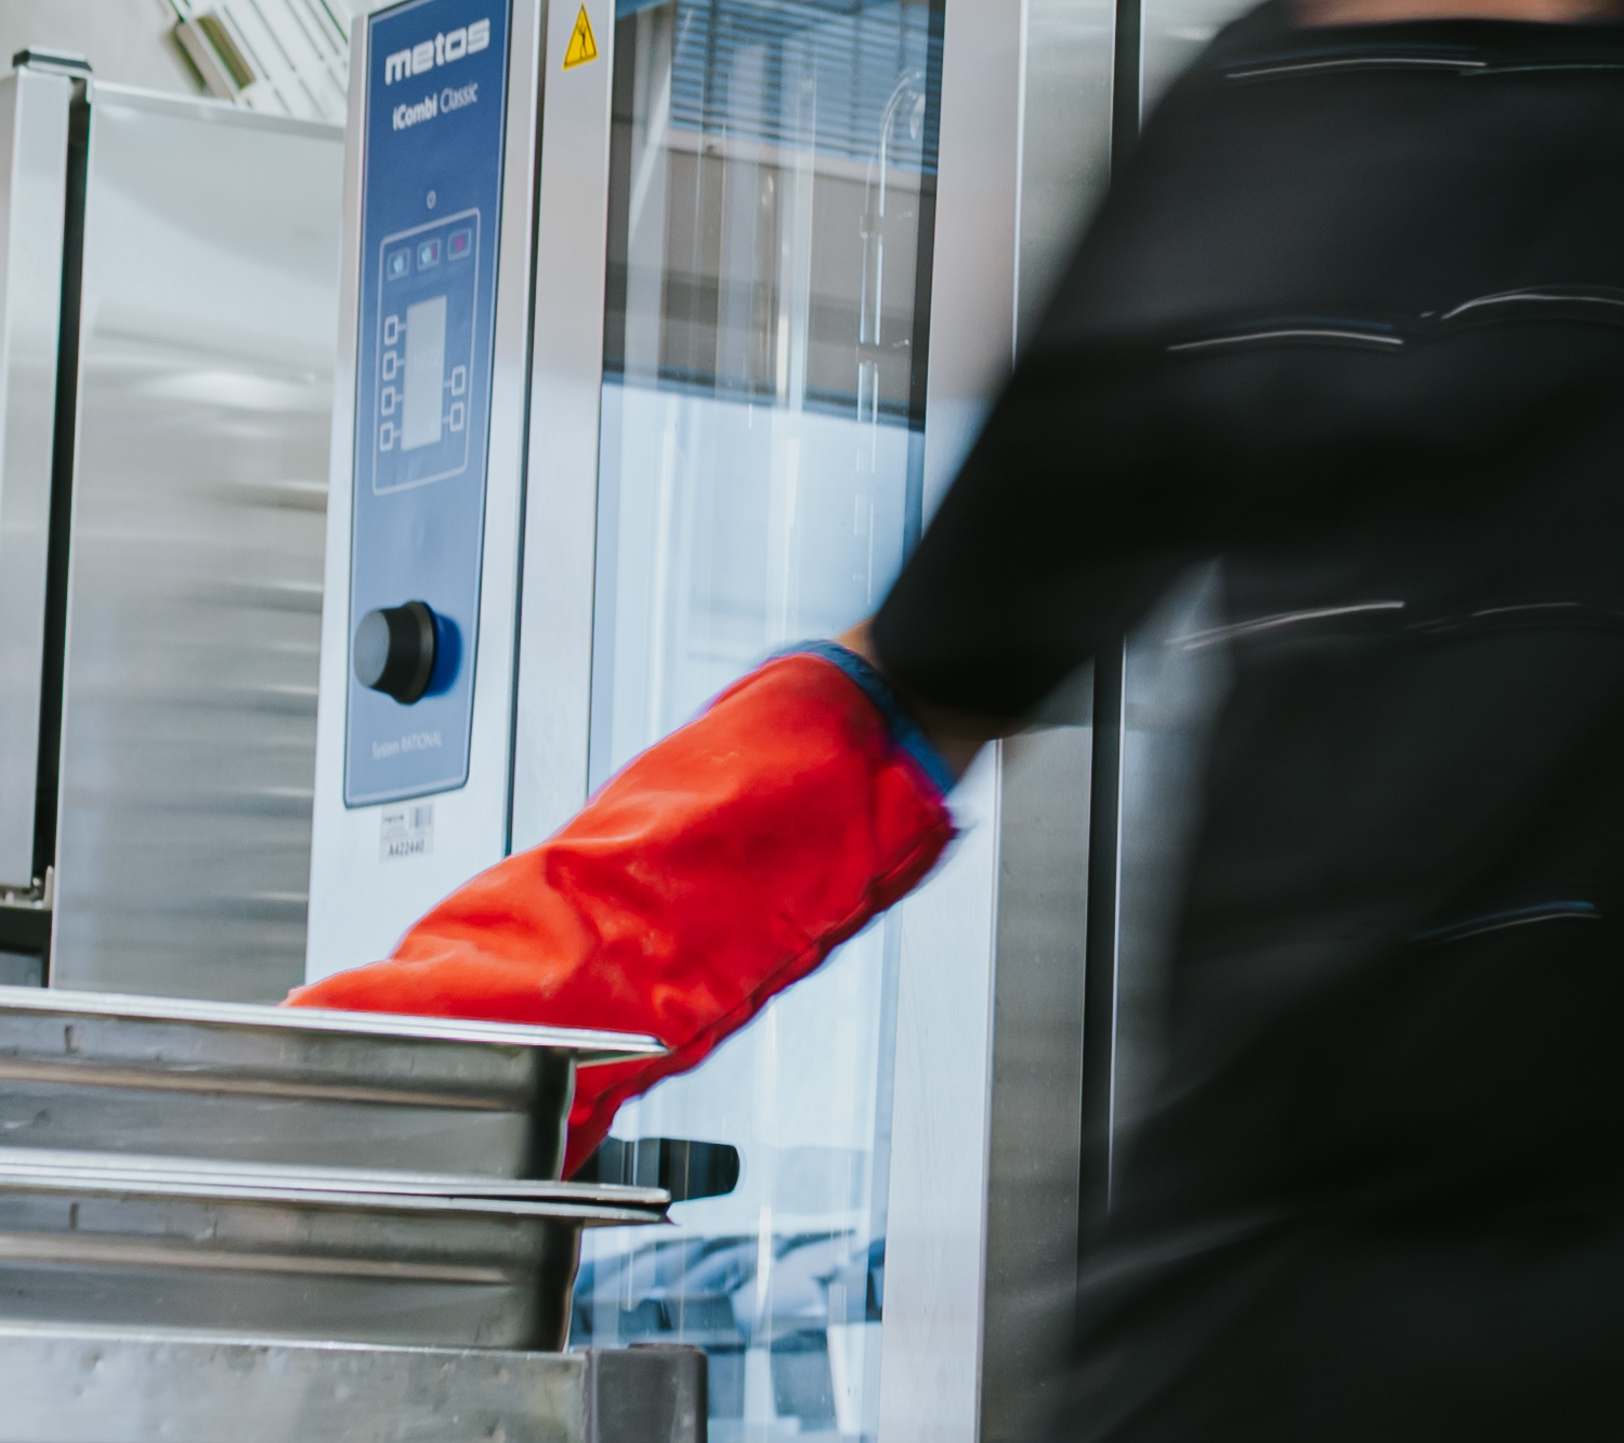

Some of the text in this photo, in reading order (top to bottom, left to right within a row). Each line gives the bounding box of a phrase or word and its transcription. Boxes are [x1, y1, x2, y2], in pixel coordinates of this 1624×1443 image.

[384, 17, 491, 85] metos
[392, 80, 479, 131] iCombi Classic
